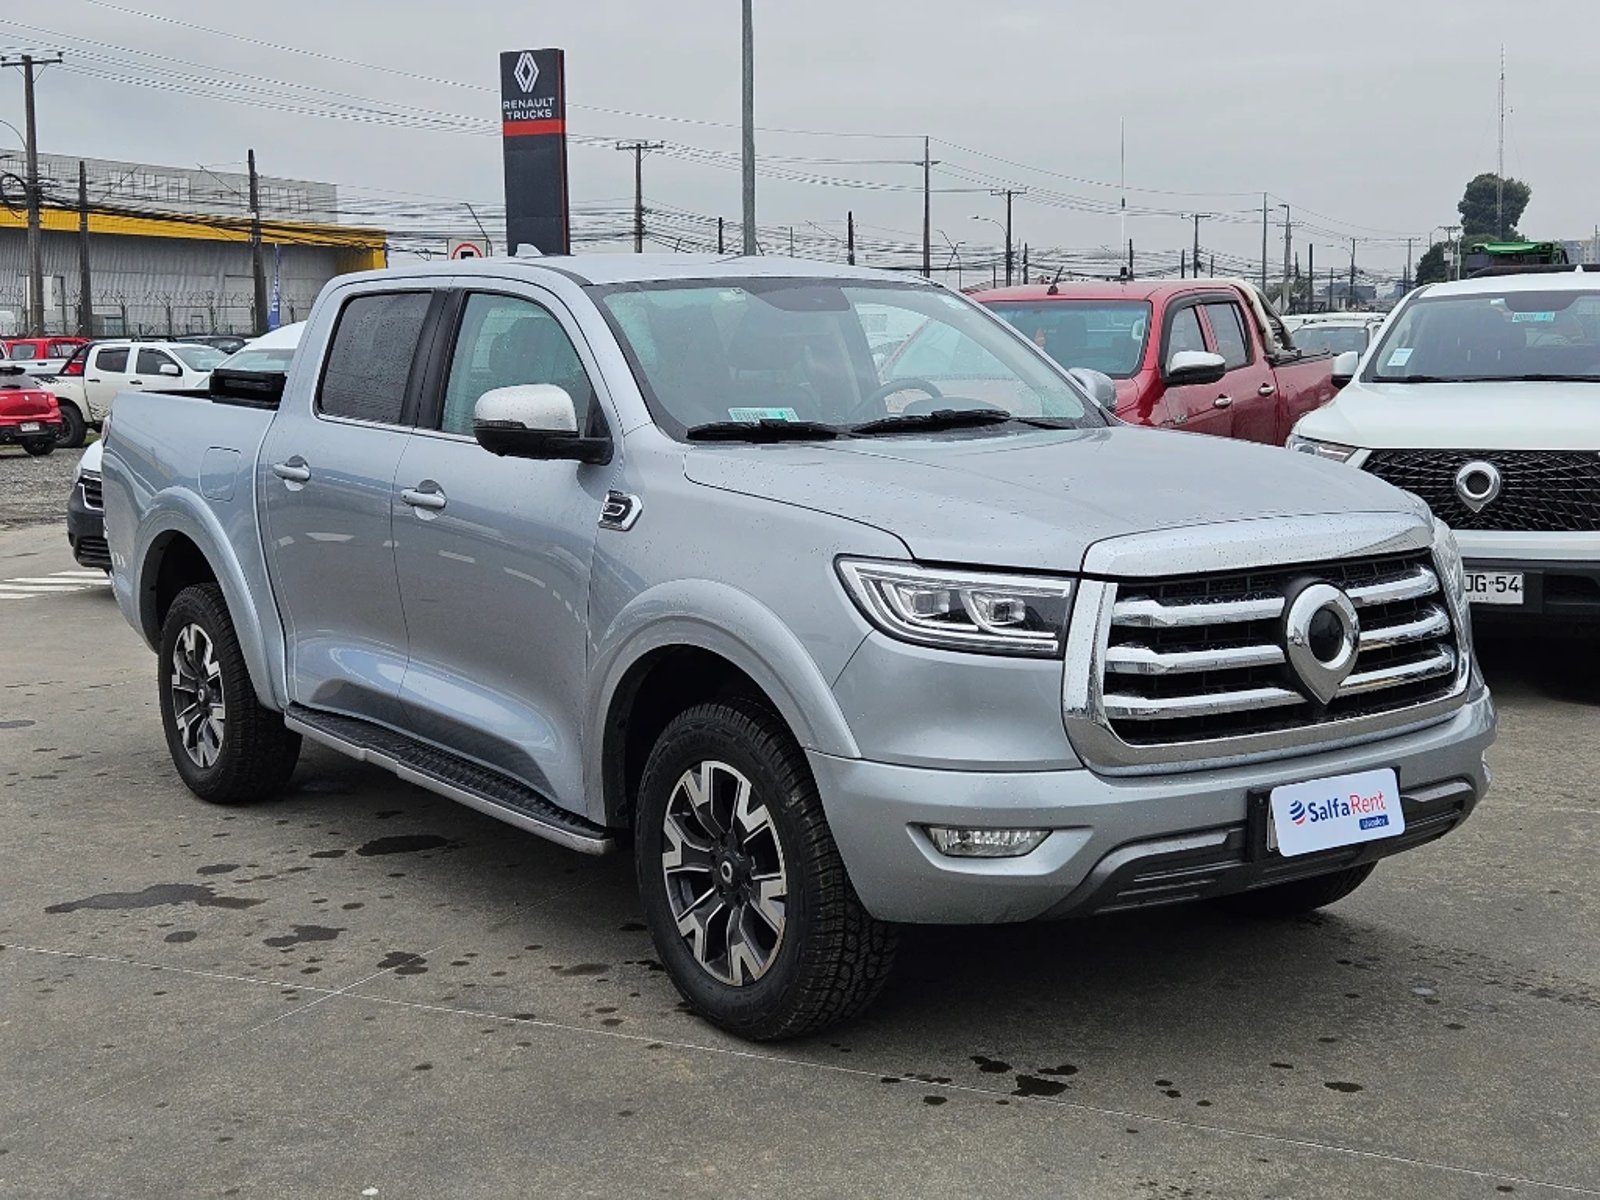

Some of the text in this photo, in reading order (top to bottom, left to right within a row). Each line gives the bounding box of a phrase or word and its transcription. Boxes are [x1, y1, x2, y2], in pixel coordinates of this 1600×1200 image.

[502, 97, 555, 110] RENAULT
[506, 108, 553, 120] TRUCKS
[1495, 575, 1521, 593] 54
[1307, 791, 1386, 823] SalfaRent
